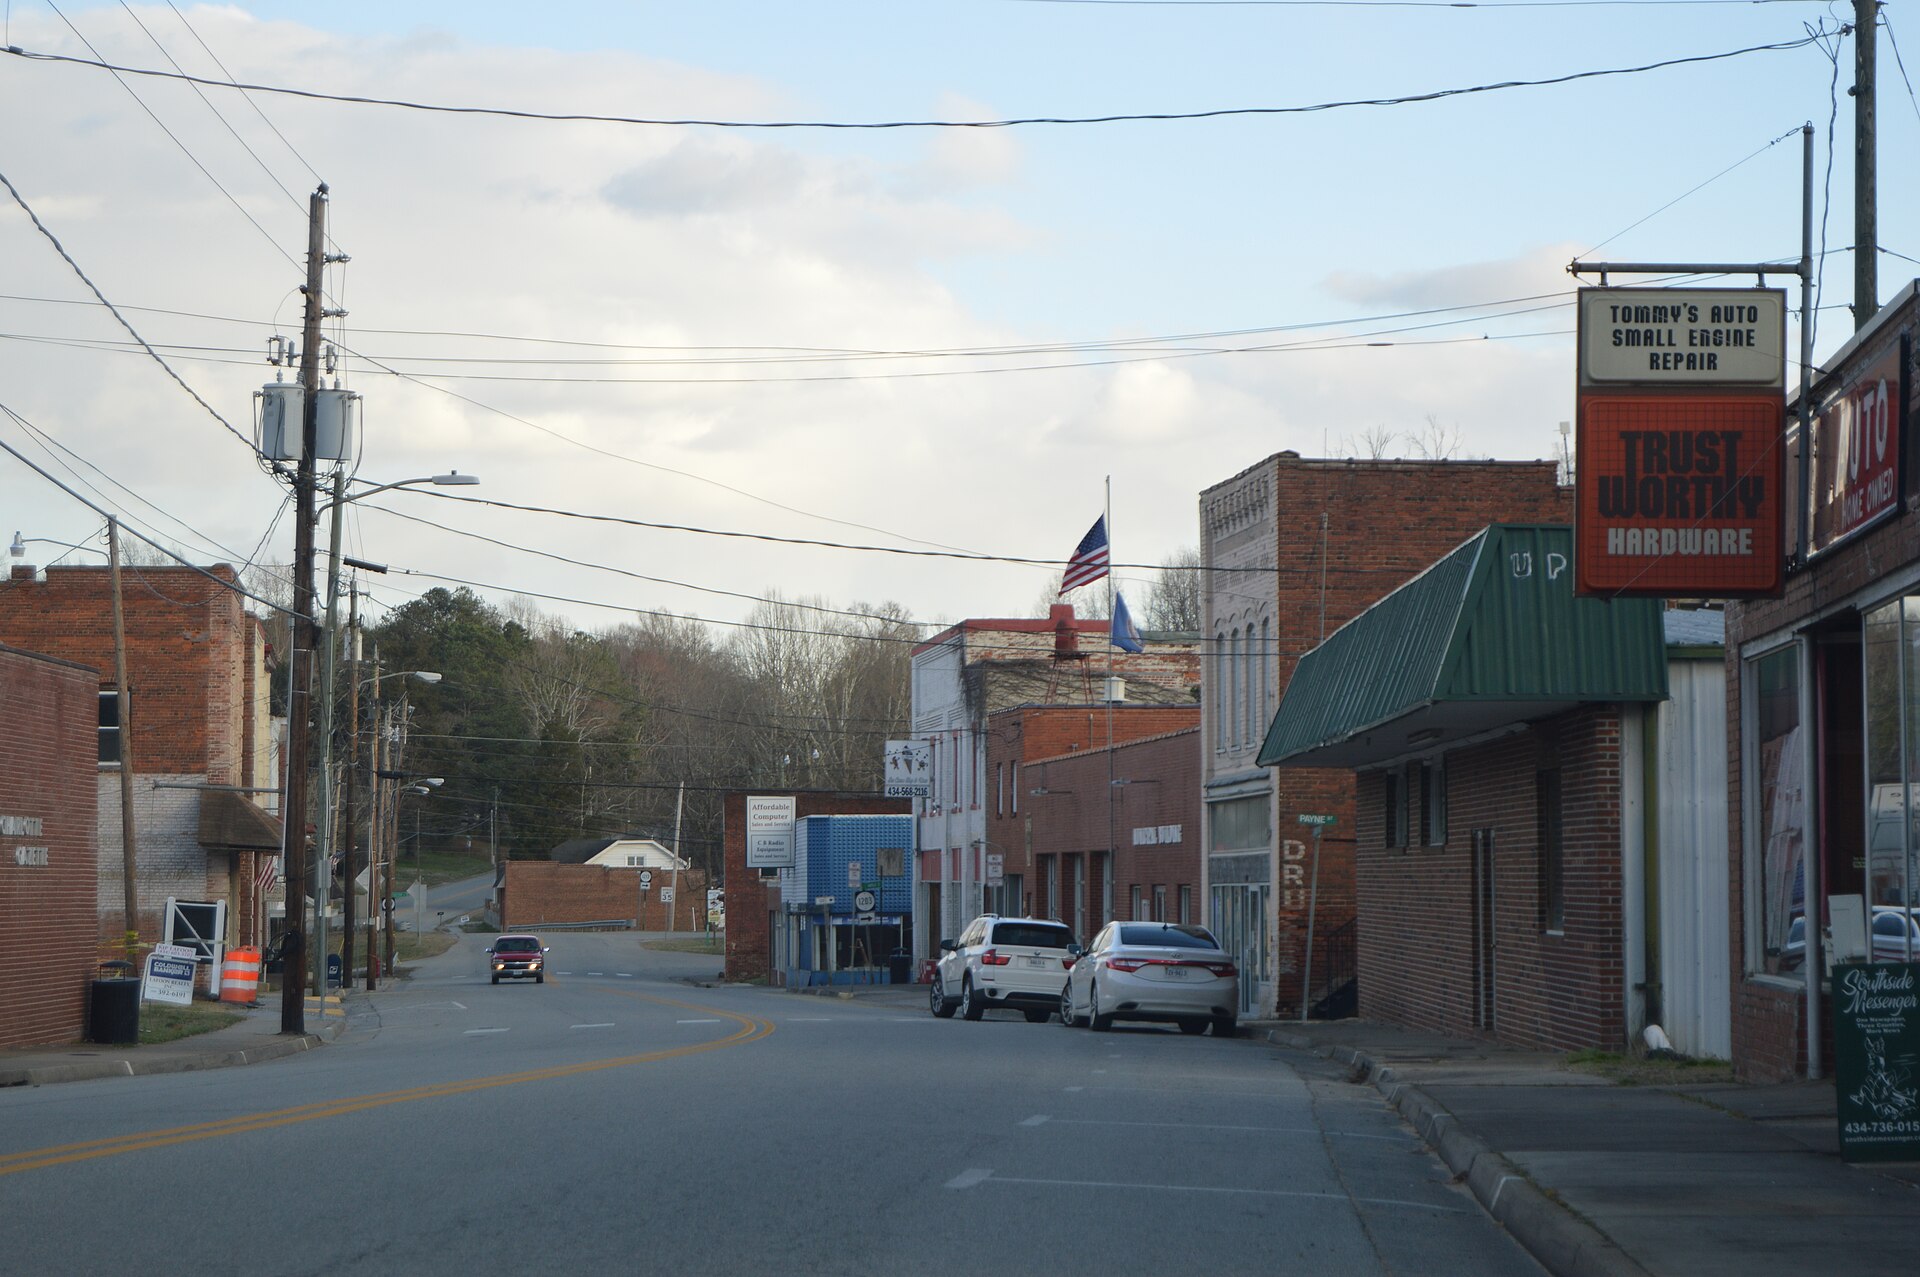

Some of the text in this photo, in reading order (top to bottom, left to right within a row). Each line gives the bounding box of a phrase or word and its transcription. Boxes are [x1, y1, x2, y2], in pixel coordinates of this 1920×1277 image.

[1610, 303, 1758, 324] TOMMY'S AUTO
[1612, 329, 1755, 347] SMALL ENGINE
[1650, 352, 1718, 370] REPAIR
[1619, 430, 1743, 475] TRUST
[1598, 475, 1765, 519] WORTHY
[1866, 466, 1894, 513] OWNED
[1608, 527, 1753, 556] HARDWARE
[752, 803, 790, 811] Affordable
[753, 813, 789, 821] Computer
[1299, 814, 1326, 824] PAYNE
[154, 962, 190, 971] COLDWELL
[1842, 968, 1915, 995] Southside
[1843, 989, 1918, 1016] Messenger
